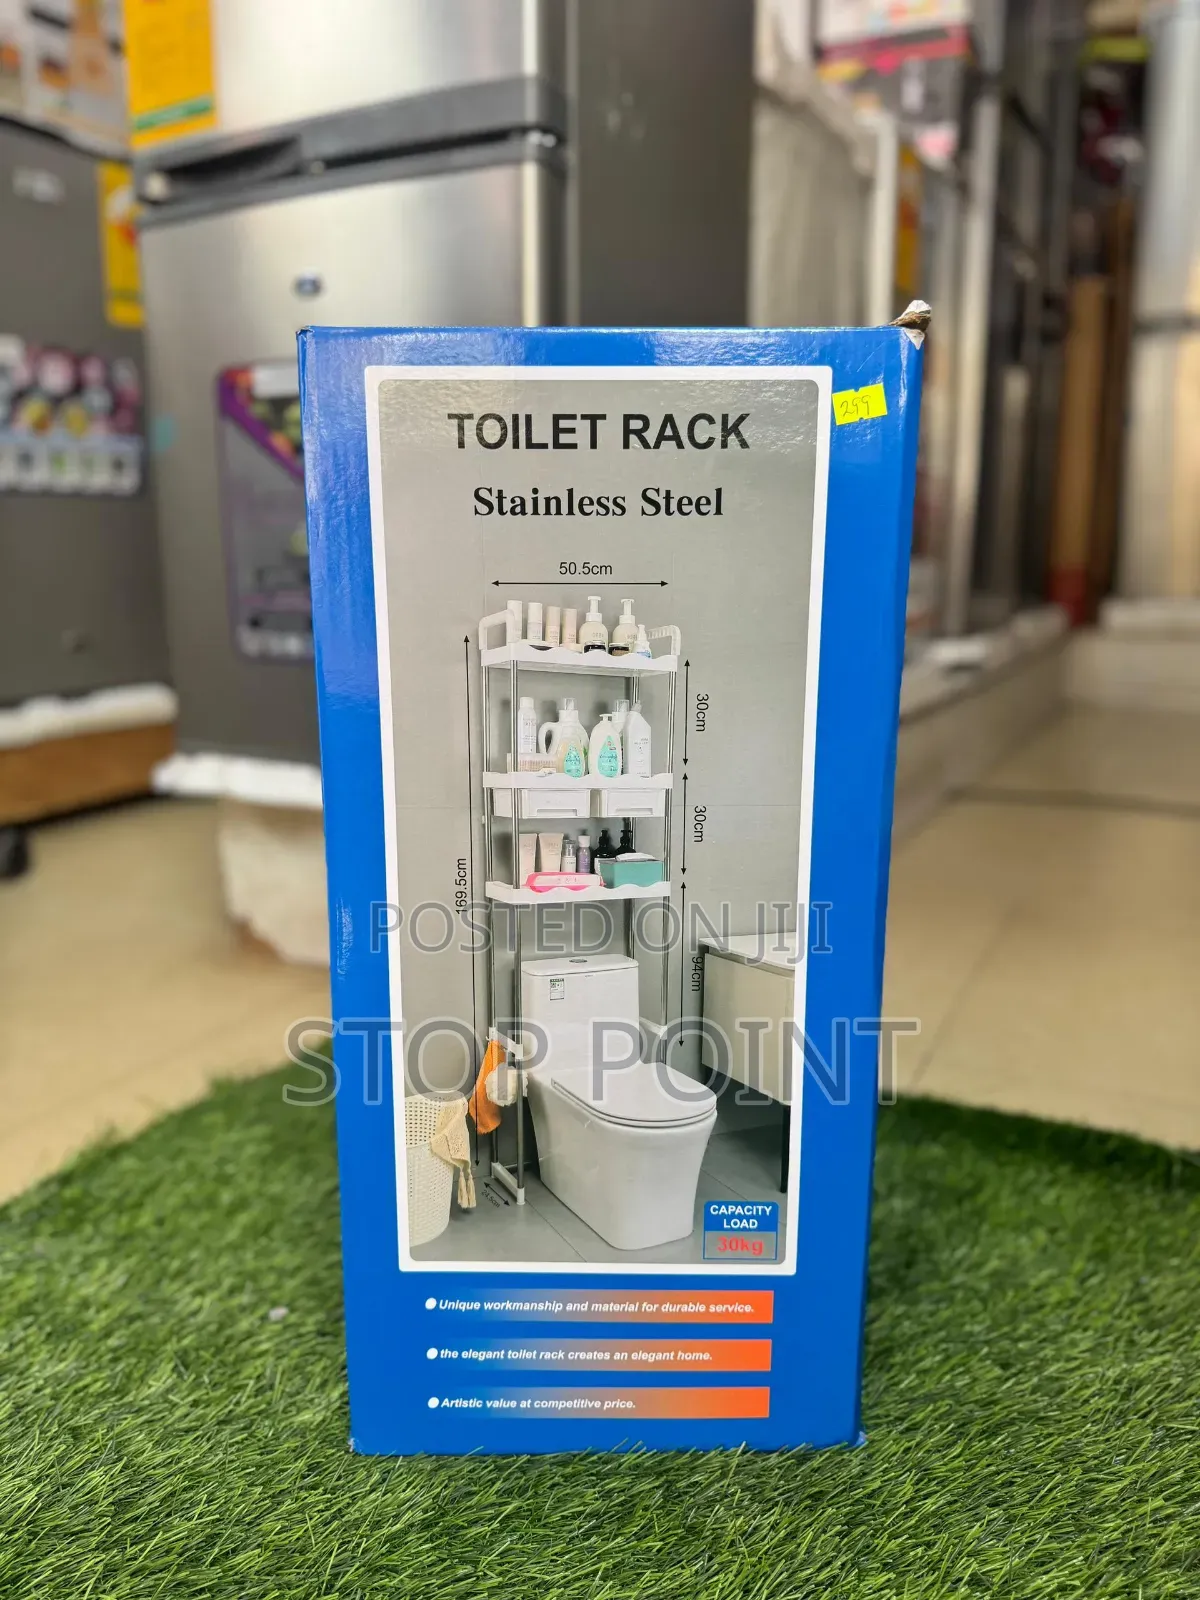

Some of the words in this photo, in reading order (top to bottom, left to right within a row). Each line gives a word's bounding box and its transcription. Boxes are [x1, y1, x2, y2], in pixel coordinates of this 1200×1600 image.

[447, 412, 607, 451] TOILET
[621, 412, 751, 450] RACK
[473, 486, 627, 518] Stainless
[640, 486, 724, 517] Steel
[558, 561, 613, 577] 50.5cm
[695, 693, 709, 733] 30cm
[693, 805, 707, 843] 30cm
[454, 858, 468, 915] 169.5cm
[691, 956, 704, 992] 94cm
[709, 1204, 773, 1217] CAPACITY
[722, 1218, 758, 1230] LOAD
[717, 1235, 765, 1257] 30kg
[438, 1299, 481, 1313] Unique
[483, 1300, 563, 1314] workmanship
[565, 1301, 588, 1312] and
[590, 1301, 639, 1313] material
[641, 1301, 660, 1313] for
[661, 1301, 706, 1313] durable
[708, 1302, 755, 1314] service.
[439, 1348, 459, 1360] the
[460, 1348, 505, 1362] elegant
[506, 1348, 538, 1360] toilet
[538, 1349, 566, 1361] rack
[567, 1350, 611, 1361] creates
[612, 1351, 629, 1361] an
[630, 1350, 675, 1364] elegant
[676, 1350, 713, 1362] home.
[440, 1397, 483, 1409] Artistic
[485, 1397, 518, 1409] value
[519, 1398, 532, 1409] at
[533, 1397, 602, 1412] competitive
[603, 1398, 636, 1412] price.
